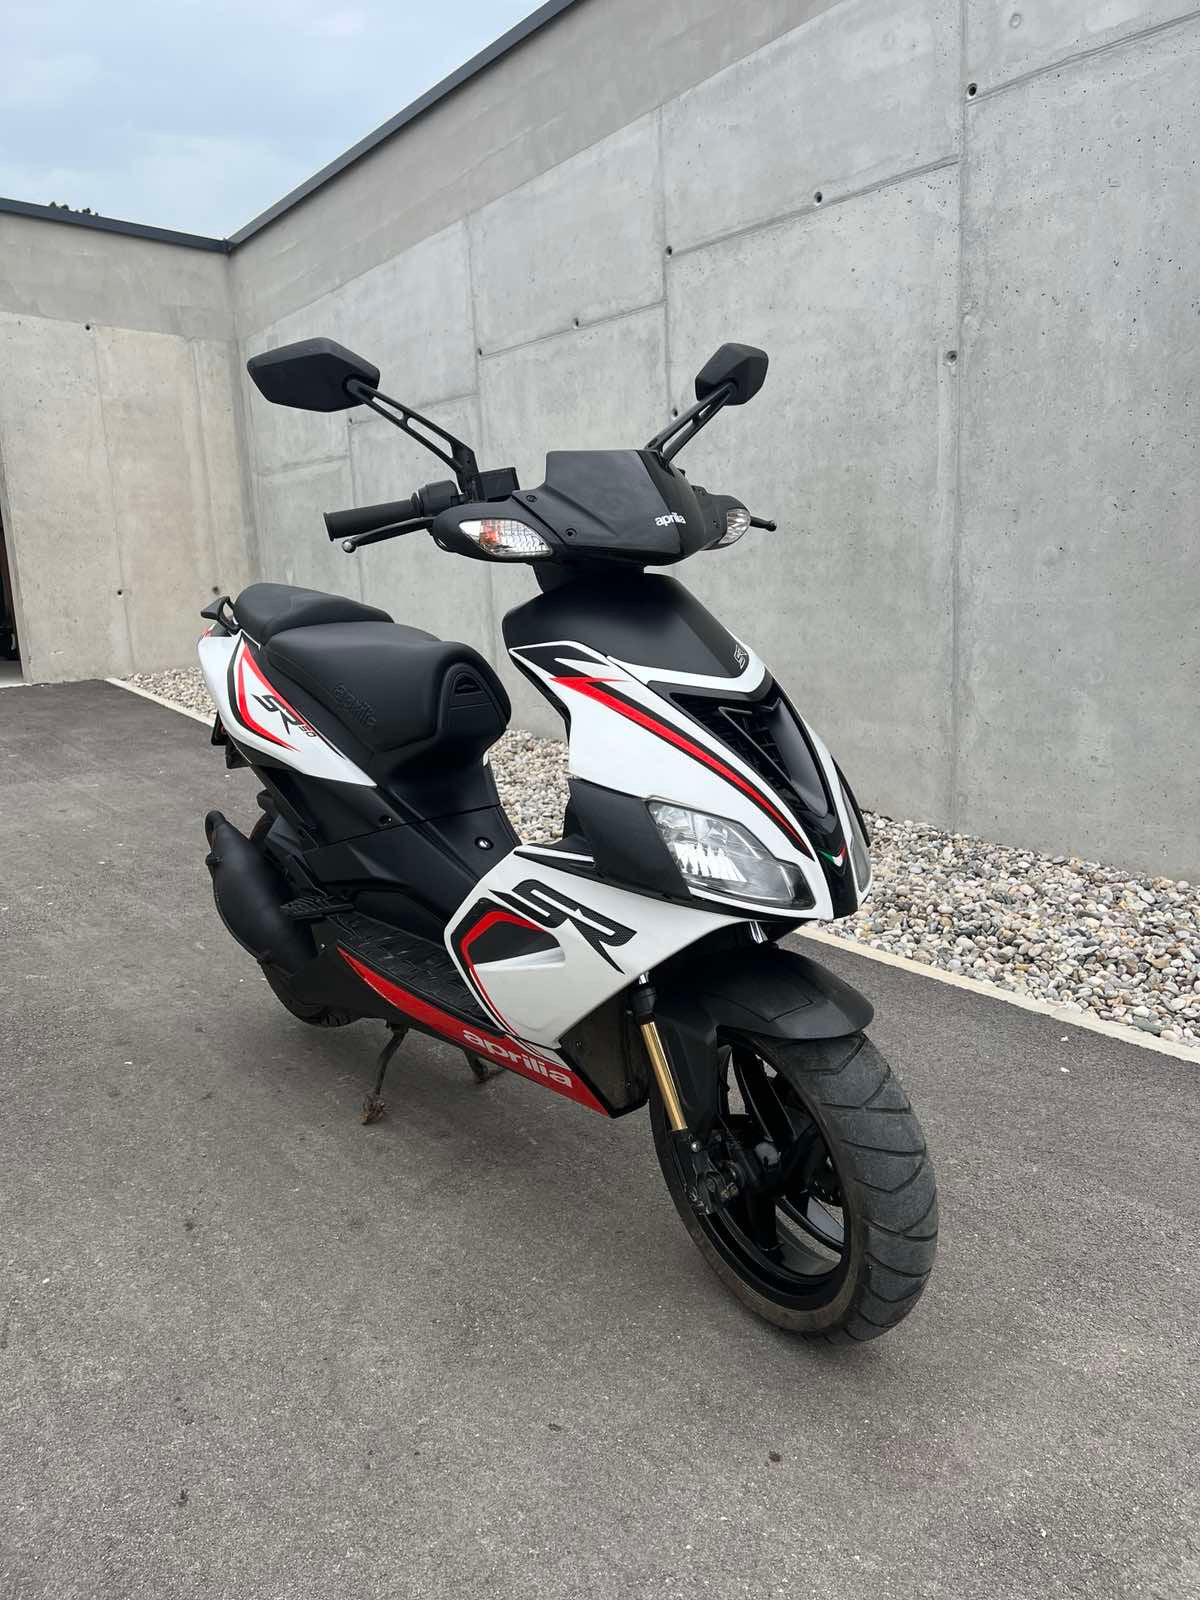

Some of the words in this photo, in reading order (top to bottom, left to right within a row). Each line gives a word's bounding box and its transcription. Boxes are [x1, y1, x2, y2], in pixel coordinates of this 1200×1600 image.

[654, 511, 687, 527] aprilia
[488, 878, 638, 976] SR
[462, 1029, 574, 1089] aprilia
